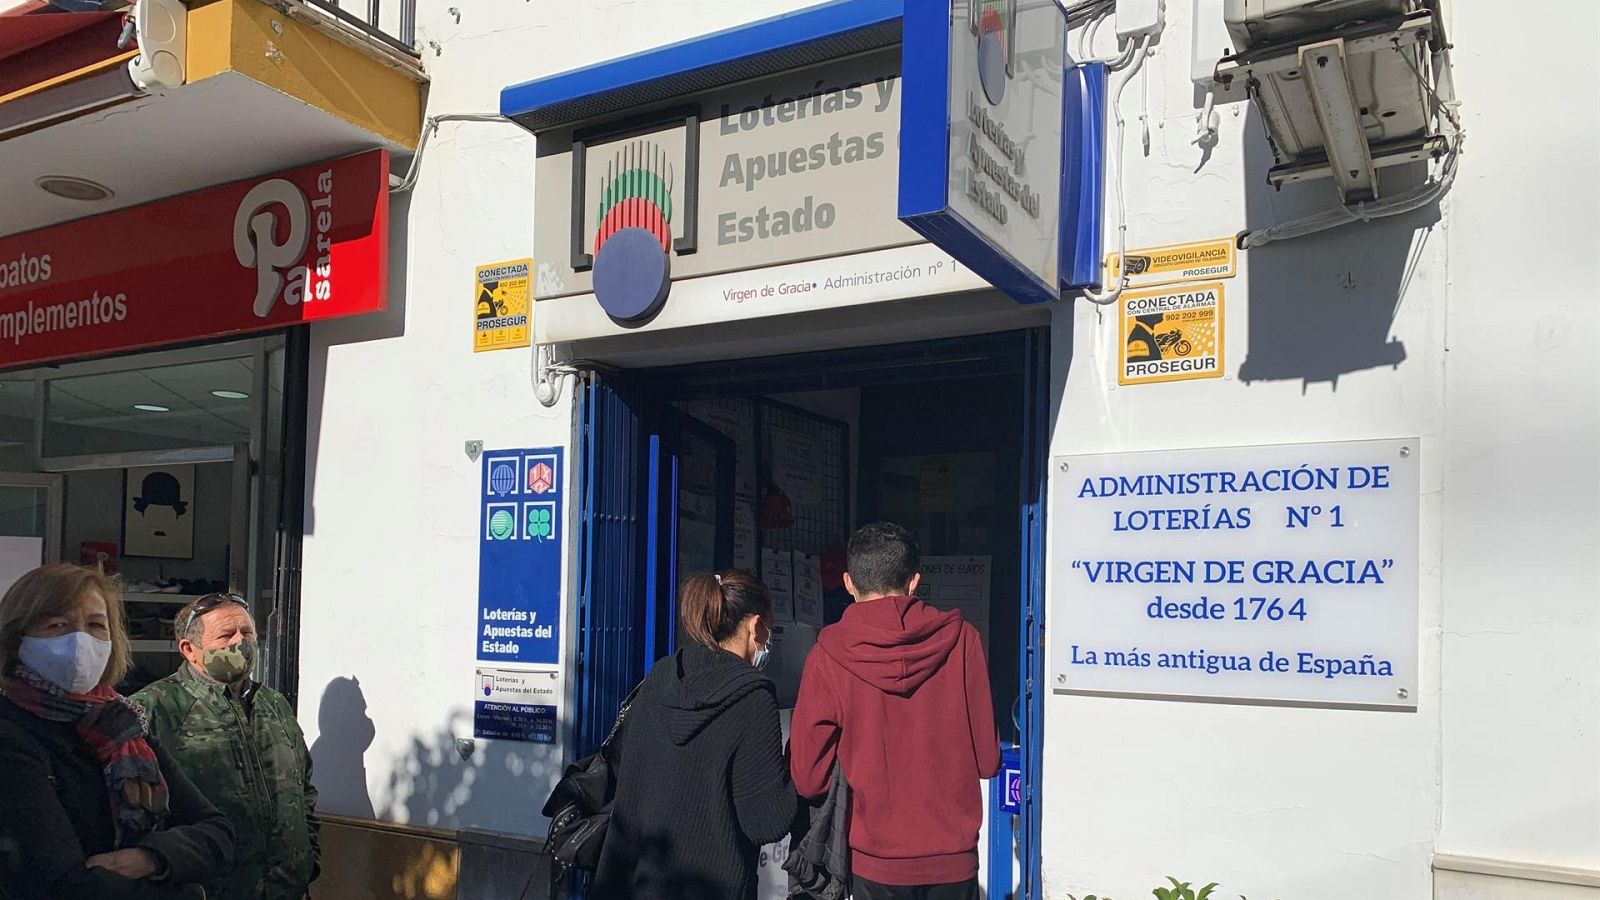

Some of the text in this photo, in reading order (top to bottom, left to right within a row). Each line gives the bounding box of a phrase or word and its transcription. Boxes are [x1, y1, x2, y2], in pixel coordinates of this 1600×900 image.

[720, 74, 897, 136] Loterías y
[719, 131, 884, 192] Apuestas
[967, 130, 1040, 220] Apuestas del
[966, 166, 1009, 226] Estado
[718, 196, 836, 246] Estado
[1152, 248, 1226, 264] VIDEOVIGILANCIA
[478, 264, 529, 279] CONECTADA
[723, 286, 758, 304] Virgen
[760, 283, 775, 297] de
[823, 265, 921, 290] Administración
[950, 260, 957, 272] 1
[1182, 265, 1229, 277] PROSEGUR
[1127, 291, 1216, 311] CONECTADA
[1142, 306, 1171, 314] CENTRAL
[1183, 300, 1216, 309] ALARMAS
[477, 315, 527, 330] PROSEGUR
[1126, 357, 1216, 376] PROSEGUR
[1077, 464, 1390, 499] ADMINISTRACIÓN DE
[1113, 503, 1251, 532] LOTERÍAS
[1329, 505, 1345, 528] 1
[1203, 560, 1245, 584] DE
[483, 607, 537, 625] Loterías y
[1146, 596, 1307, 622] desde 1764
[482, 624, 553, 640] Apuestas del
[482, 640, 520, 654] Estado
[1071, 645, 1394, 679] La más antigua de España
[484, 703, 512, 712] ATENCIÓN
